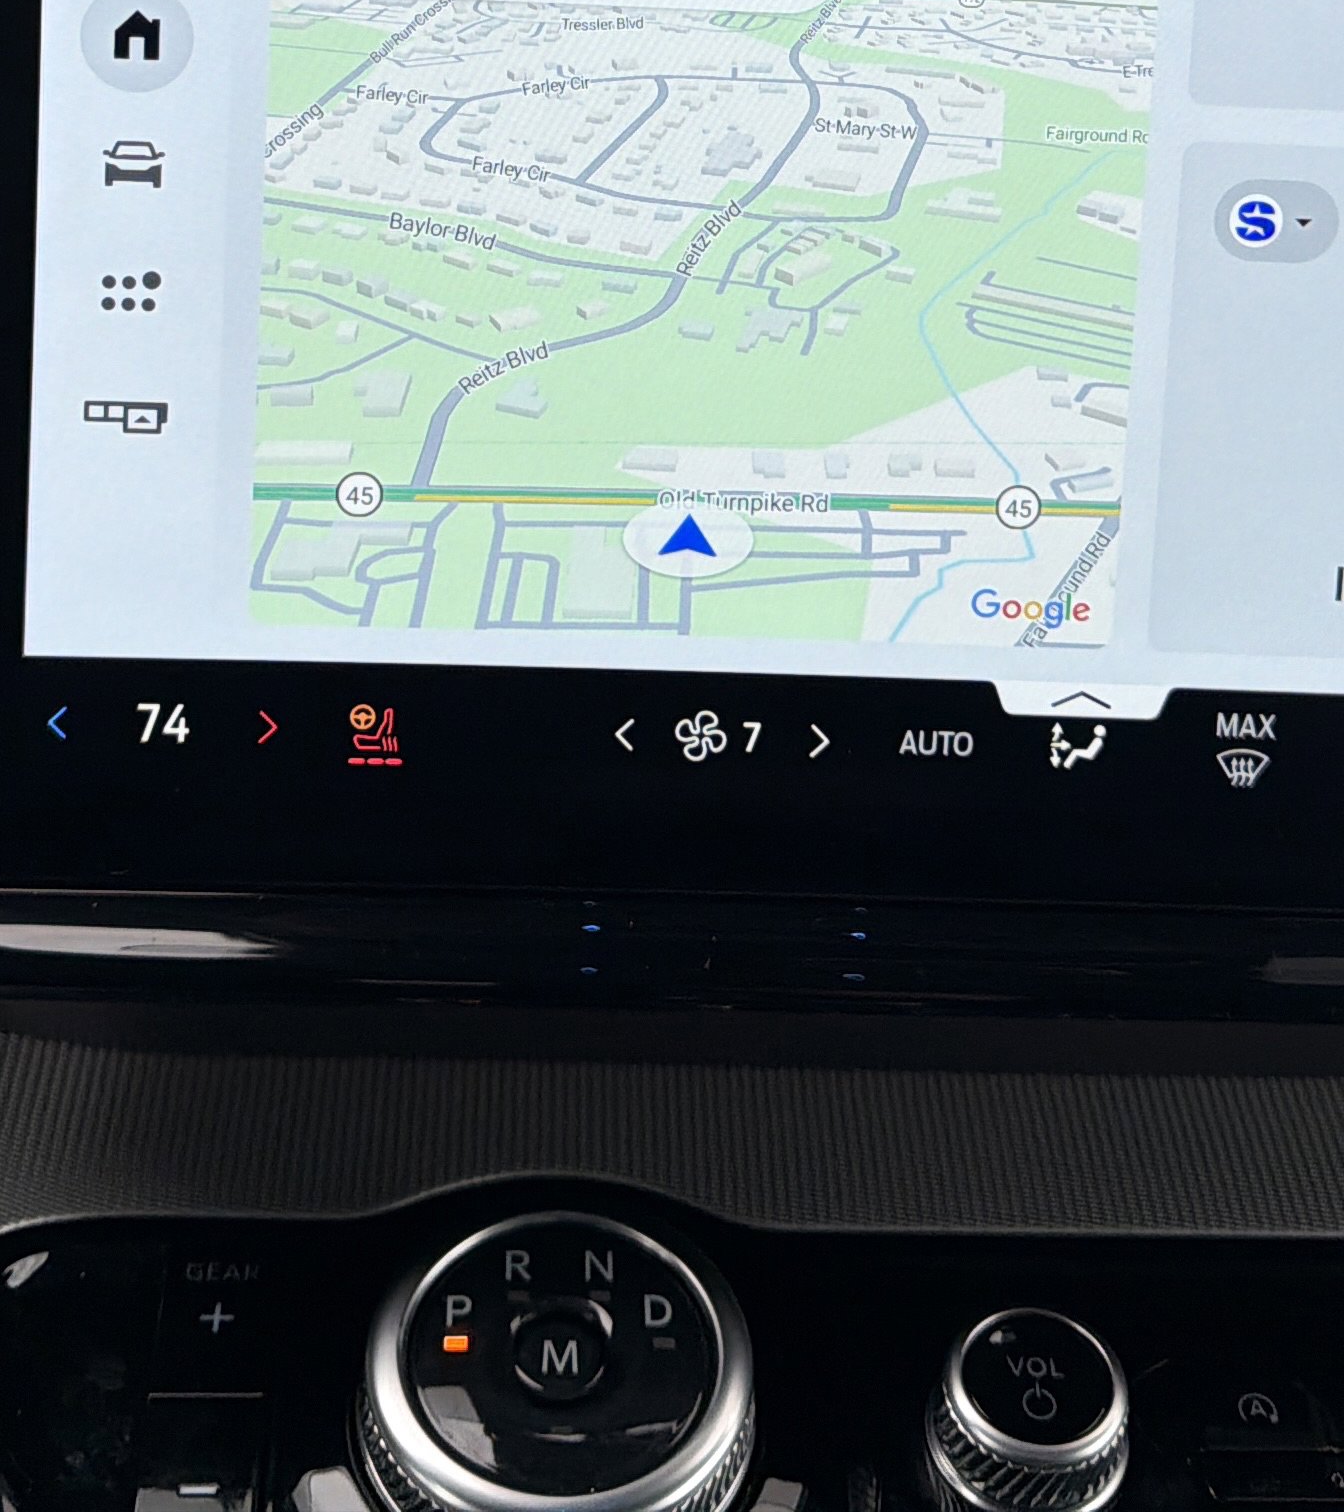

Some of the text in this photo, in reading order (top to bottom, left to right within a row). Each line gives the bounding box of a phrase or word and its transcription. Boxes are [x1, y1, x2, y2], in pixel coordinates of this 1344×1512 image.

[562, 17, 644, 31] Tressler Blvd
[800, 18, 824, 45] Reitz
[370, 40, 395, 64] Bull
[390, 21, 417, 47] Run
[356, 85, 429, 106] Farley Cir
[522, 76, 590, 96] Farley Cir
[815, 118, 919, 140] St Mary St W
[1047, 126, 1127, 144] Fairground
[472, 156, 551, 182] Farley Cir
[390, 212, 497, 251] Baylor Blvd
[677, 199, 741, 278] Reitz Blvd
[457, 341, 549, 395] Reitz Blvd
[346, 486, 374, 506] 45
[703, 491, 794, 514] Turnpike
[801, 495, 828, 513] Rd
[1006, 499, 1032, 520] 45
[1086, 531, 1111, 558] Rd
[971, 589, 1091, 629] Google
[135, 704, 190, 744] 74
[743, 722, 762, 753] 7
[1216, 713, 1277, 740] MAX
[899, 730, 974, 757] AUTO
[505, 1251, 532, 1280] R
[584, 1251, 614, 1281] N
[444, 1297, 473, 1327] P
[644, 1297, 674, 1327] D
[542, 1340, 579, 1375] M
[1005, 1353, 1066, 1379] VOL
